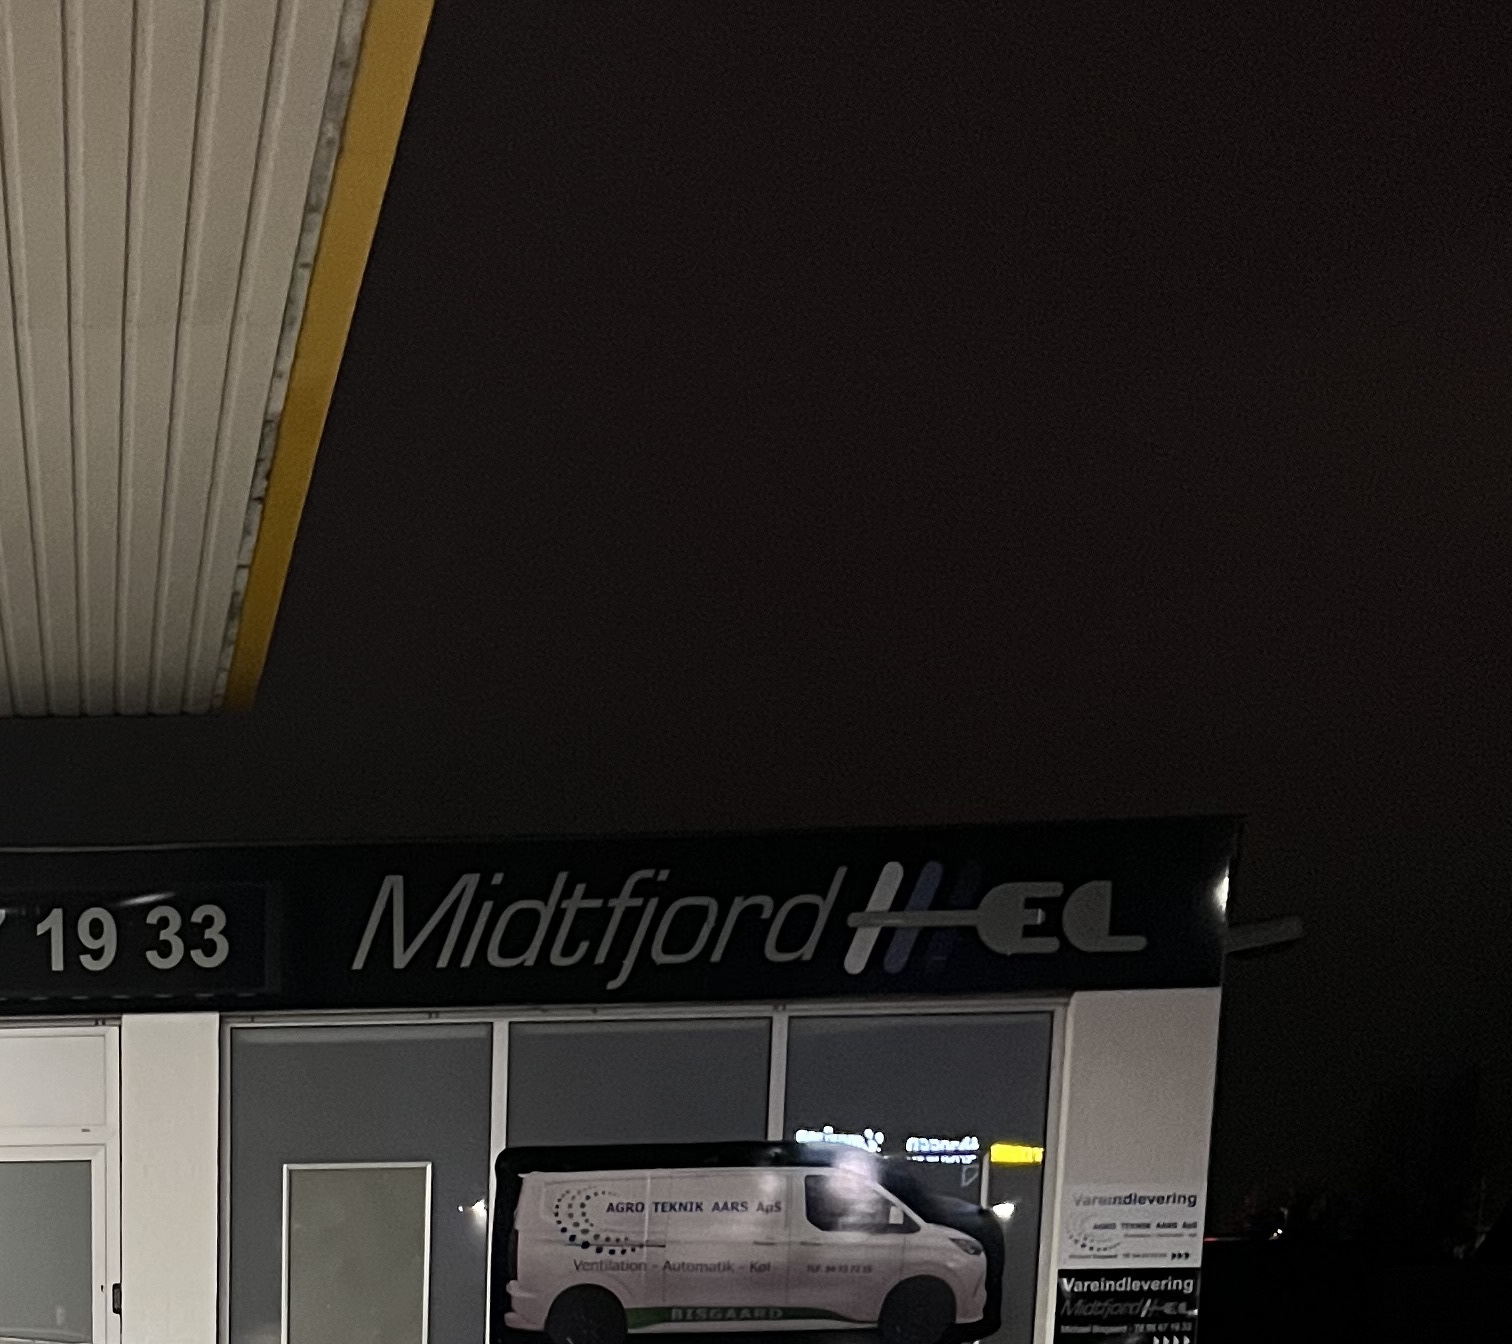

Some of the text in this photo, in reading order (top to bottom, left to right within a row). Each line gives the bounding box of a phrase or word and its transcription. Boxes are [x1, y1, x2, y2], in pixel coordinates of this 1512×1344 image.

[351, 865, 848, 989] Midtfjord
[35, 907, 118, 971] 19
[145, 904, 229, 969] 33
[606, 1202, 645, 1213] AGRO
[652, 1201, 703, 1213] TEKNIK
[712, 1201, 749, 1212] AARS
[573, 1259, 647, 1272] Ventilation
[662, 1259, 733, 1272] Automatik
[1062, 1276, 1194, 1294] Vareindlevering
[671, 1307, 784, 1321] BISGAARD
